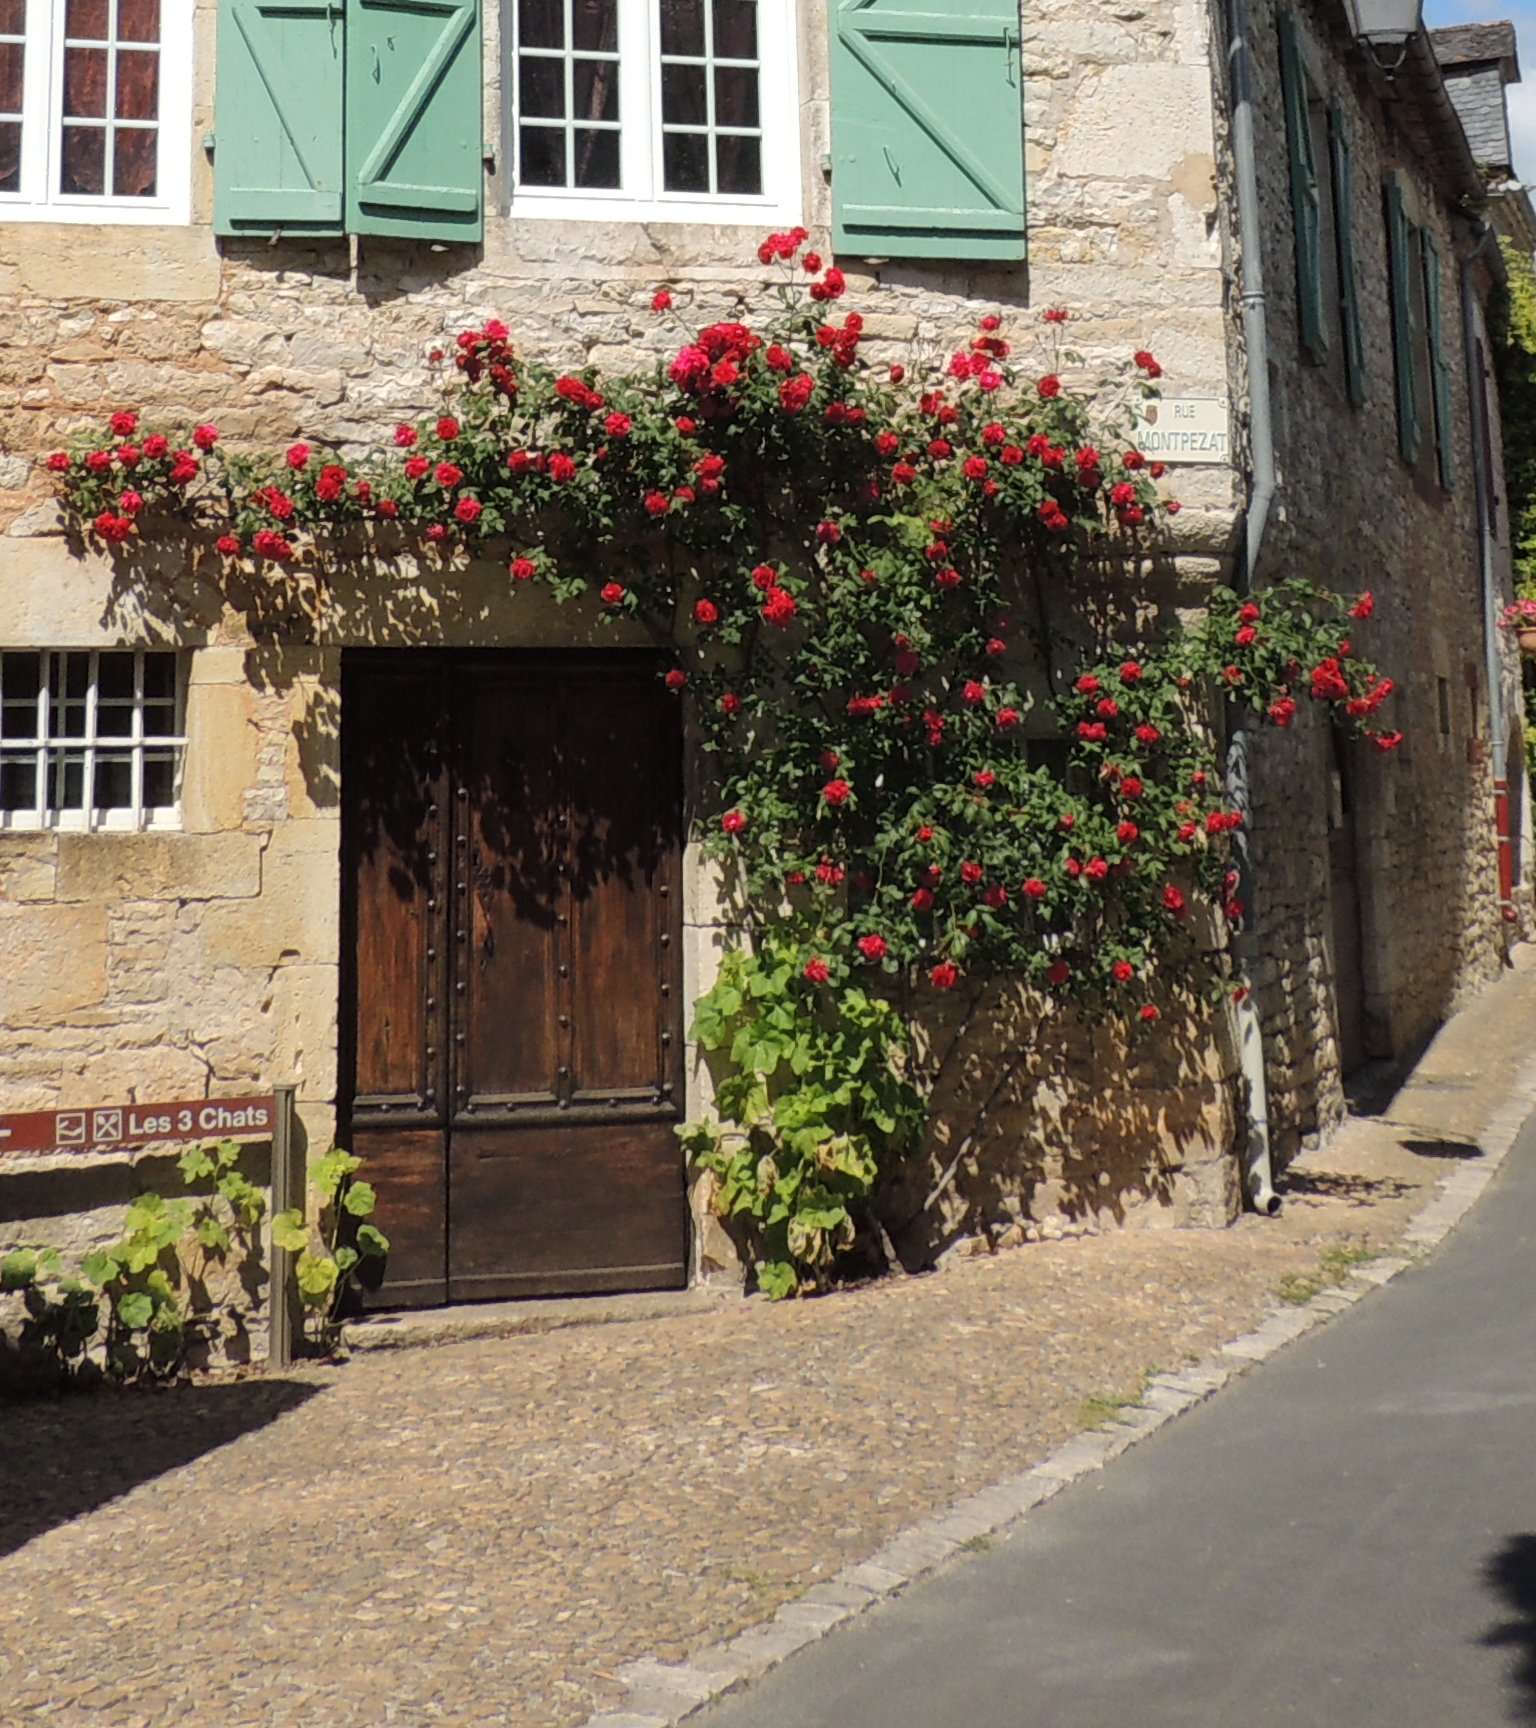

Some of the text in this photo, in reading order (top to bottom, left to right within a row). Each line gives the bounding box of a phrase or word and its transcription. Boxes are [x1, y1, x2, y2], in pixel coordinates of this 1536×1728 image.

[1174, 404, 1196, 419] RUE
[1138, 431, 1227, 451] MONTPEZAT
[129, 1106, 268, 1135] Les 3 Chats
